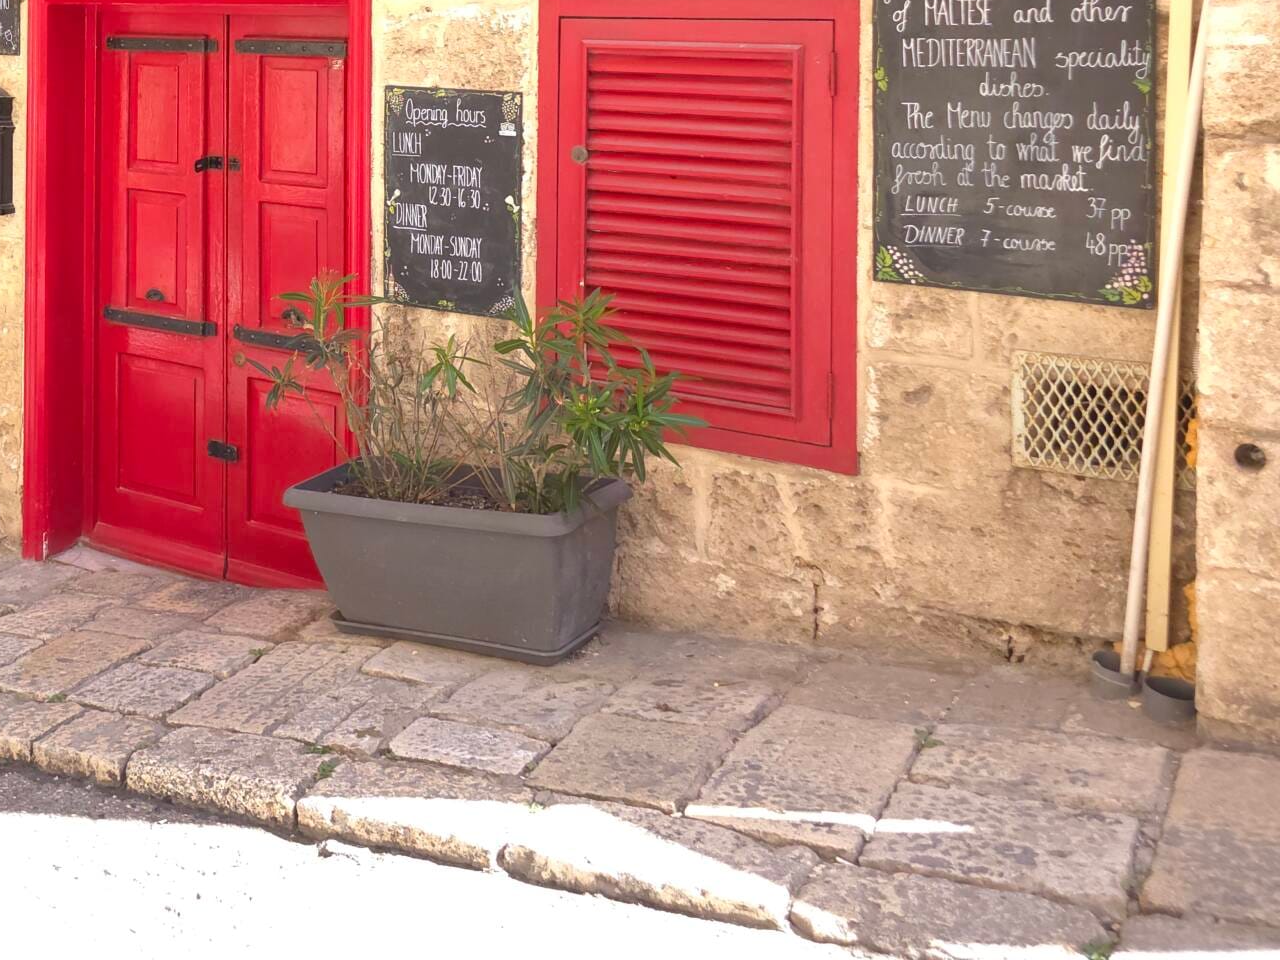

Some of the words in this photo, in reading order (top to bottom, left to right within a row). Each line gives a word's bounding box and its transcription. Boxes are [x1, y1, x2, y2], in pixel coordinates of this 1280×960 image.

[892, 0, 911, 33] of
[901, 37, 1037, 69] MEDITERRANEAN
[1055, 39, 1151, 80] speciality
[405, 98, 448, 129] Opening
[455, 98, 487, 124] hours
[901, 102, 934, 130] The
[946, 102, 992, 129] Menu
[1003, 101, 1074, 143] changes
[1086, 100, 1141, 143] daily
[392, 131, 423, 155] LUNCH
[891, 135, 975, 171] according
[987, 134, 1007, 161] to
[1015, 134, 1060, 163] what
[1071, 144, 1093, 163] we
[1095, 134, 1148, 169] find
[891, 162, 947, 195] fresh
[956, 166, 975, 188] at
[981, 162, 1011, 189] the
[395, 203, 428, 228] DINNER
[903, 195, 960, 214] LUNCH
[903, 224, 966, 247] DINNER
